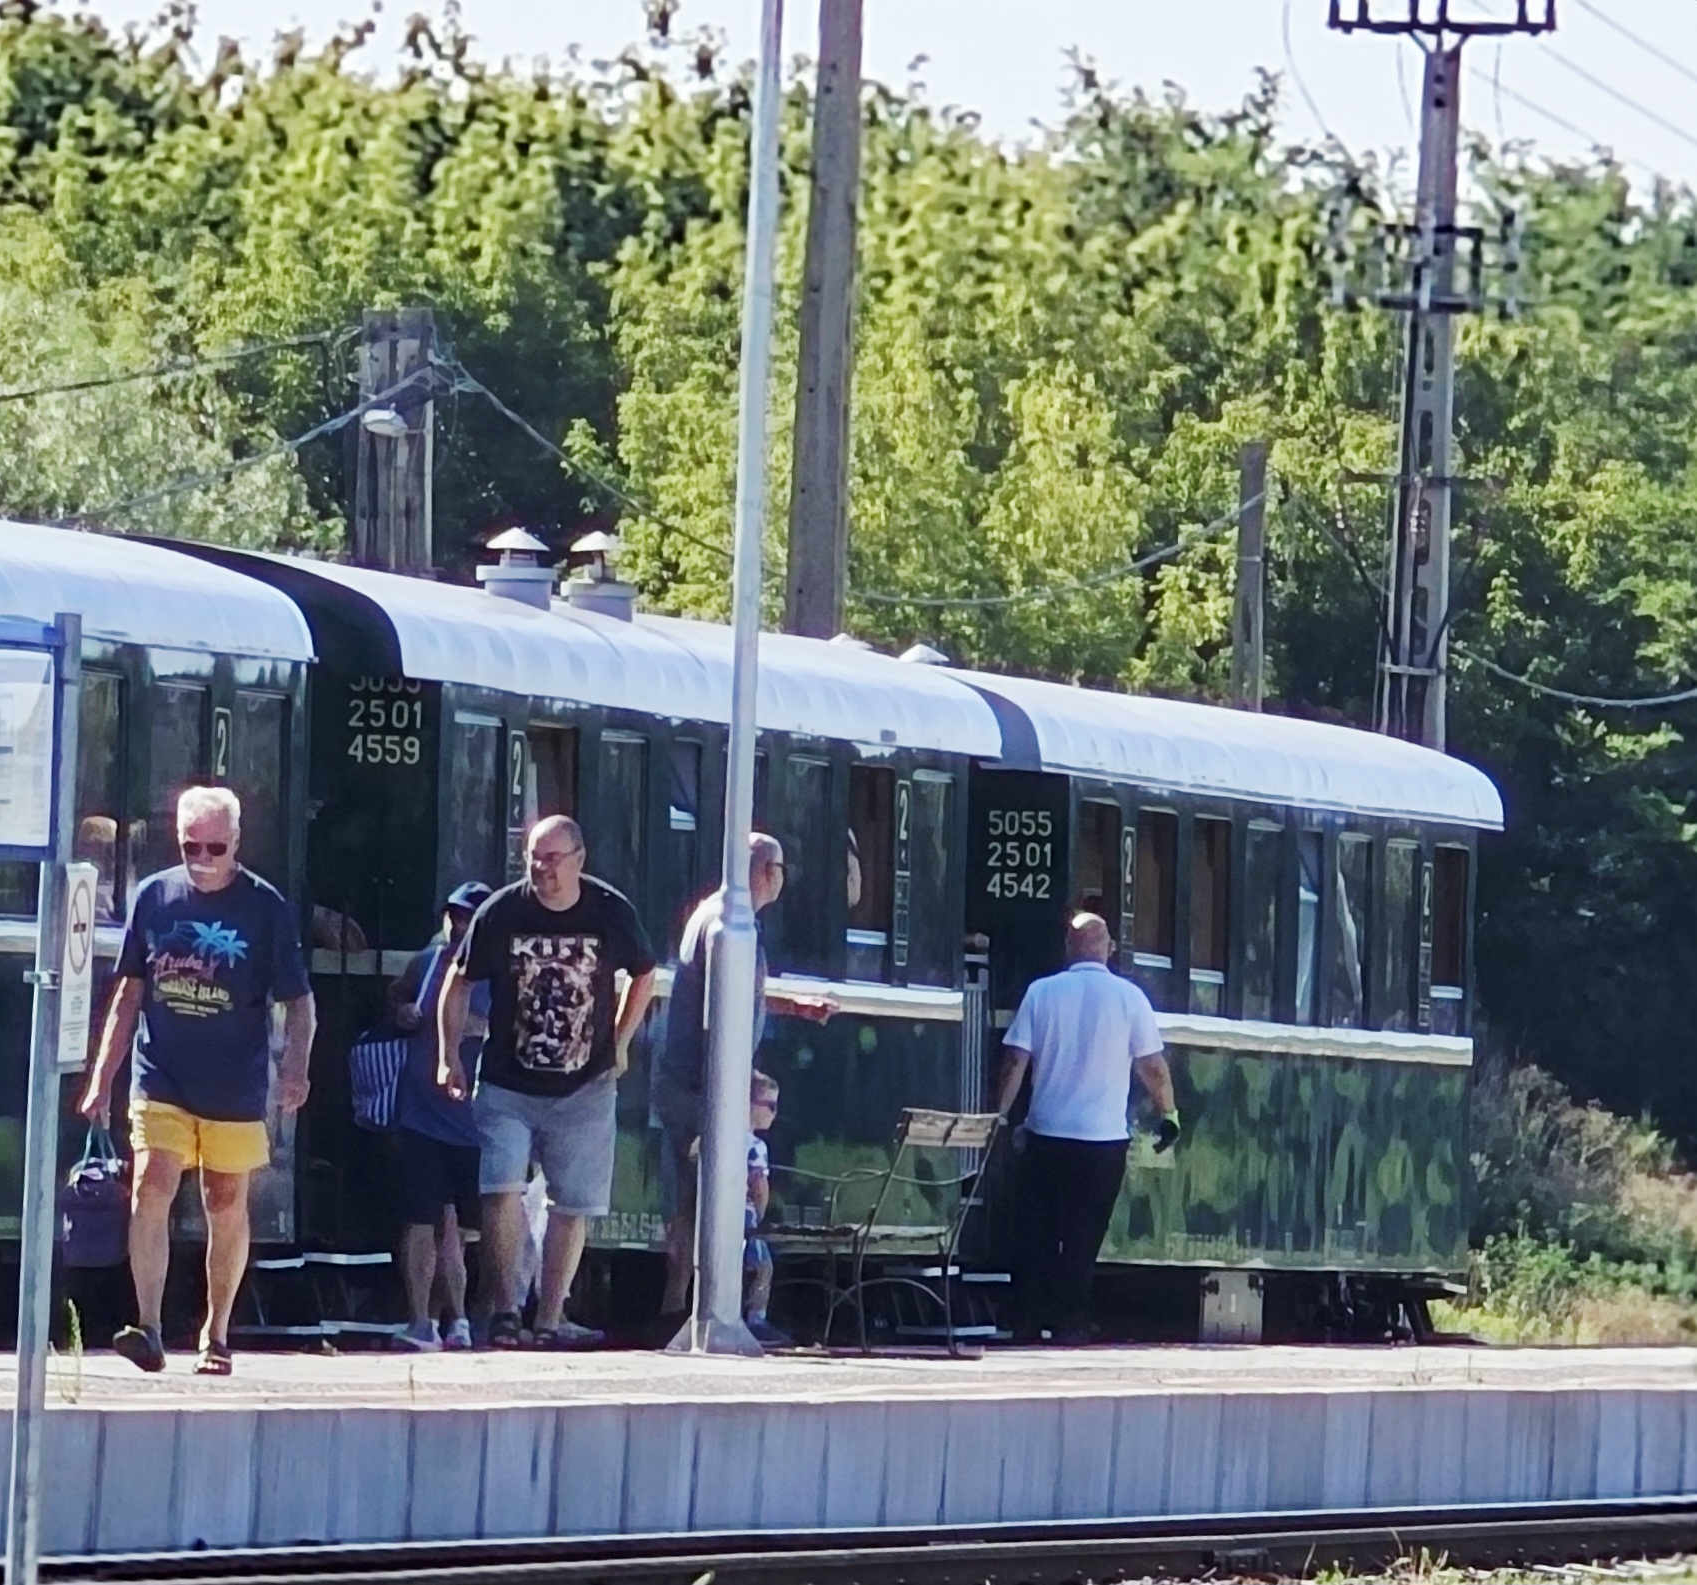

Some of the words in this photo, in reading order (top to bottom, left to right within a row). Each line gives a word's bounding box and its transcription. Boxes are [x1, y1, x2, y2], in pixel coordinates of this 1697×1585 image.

[347, 699, 422, 729] 2501
[216, 718, 227, 777] 2
[347, 734, 421, 765] 4559
[512, 740, 522, 795] 2
[899, 789, 908, 840] 2
[988, 810, 1052, 837] 5055
[986, 841, 1052, 868] 2501
[1124, 836, 1133, 884] 2
[986, 872, 1051, 899] 4542
[1422, 870, 1431, 916] 2
